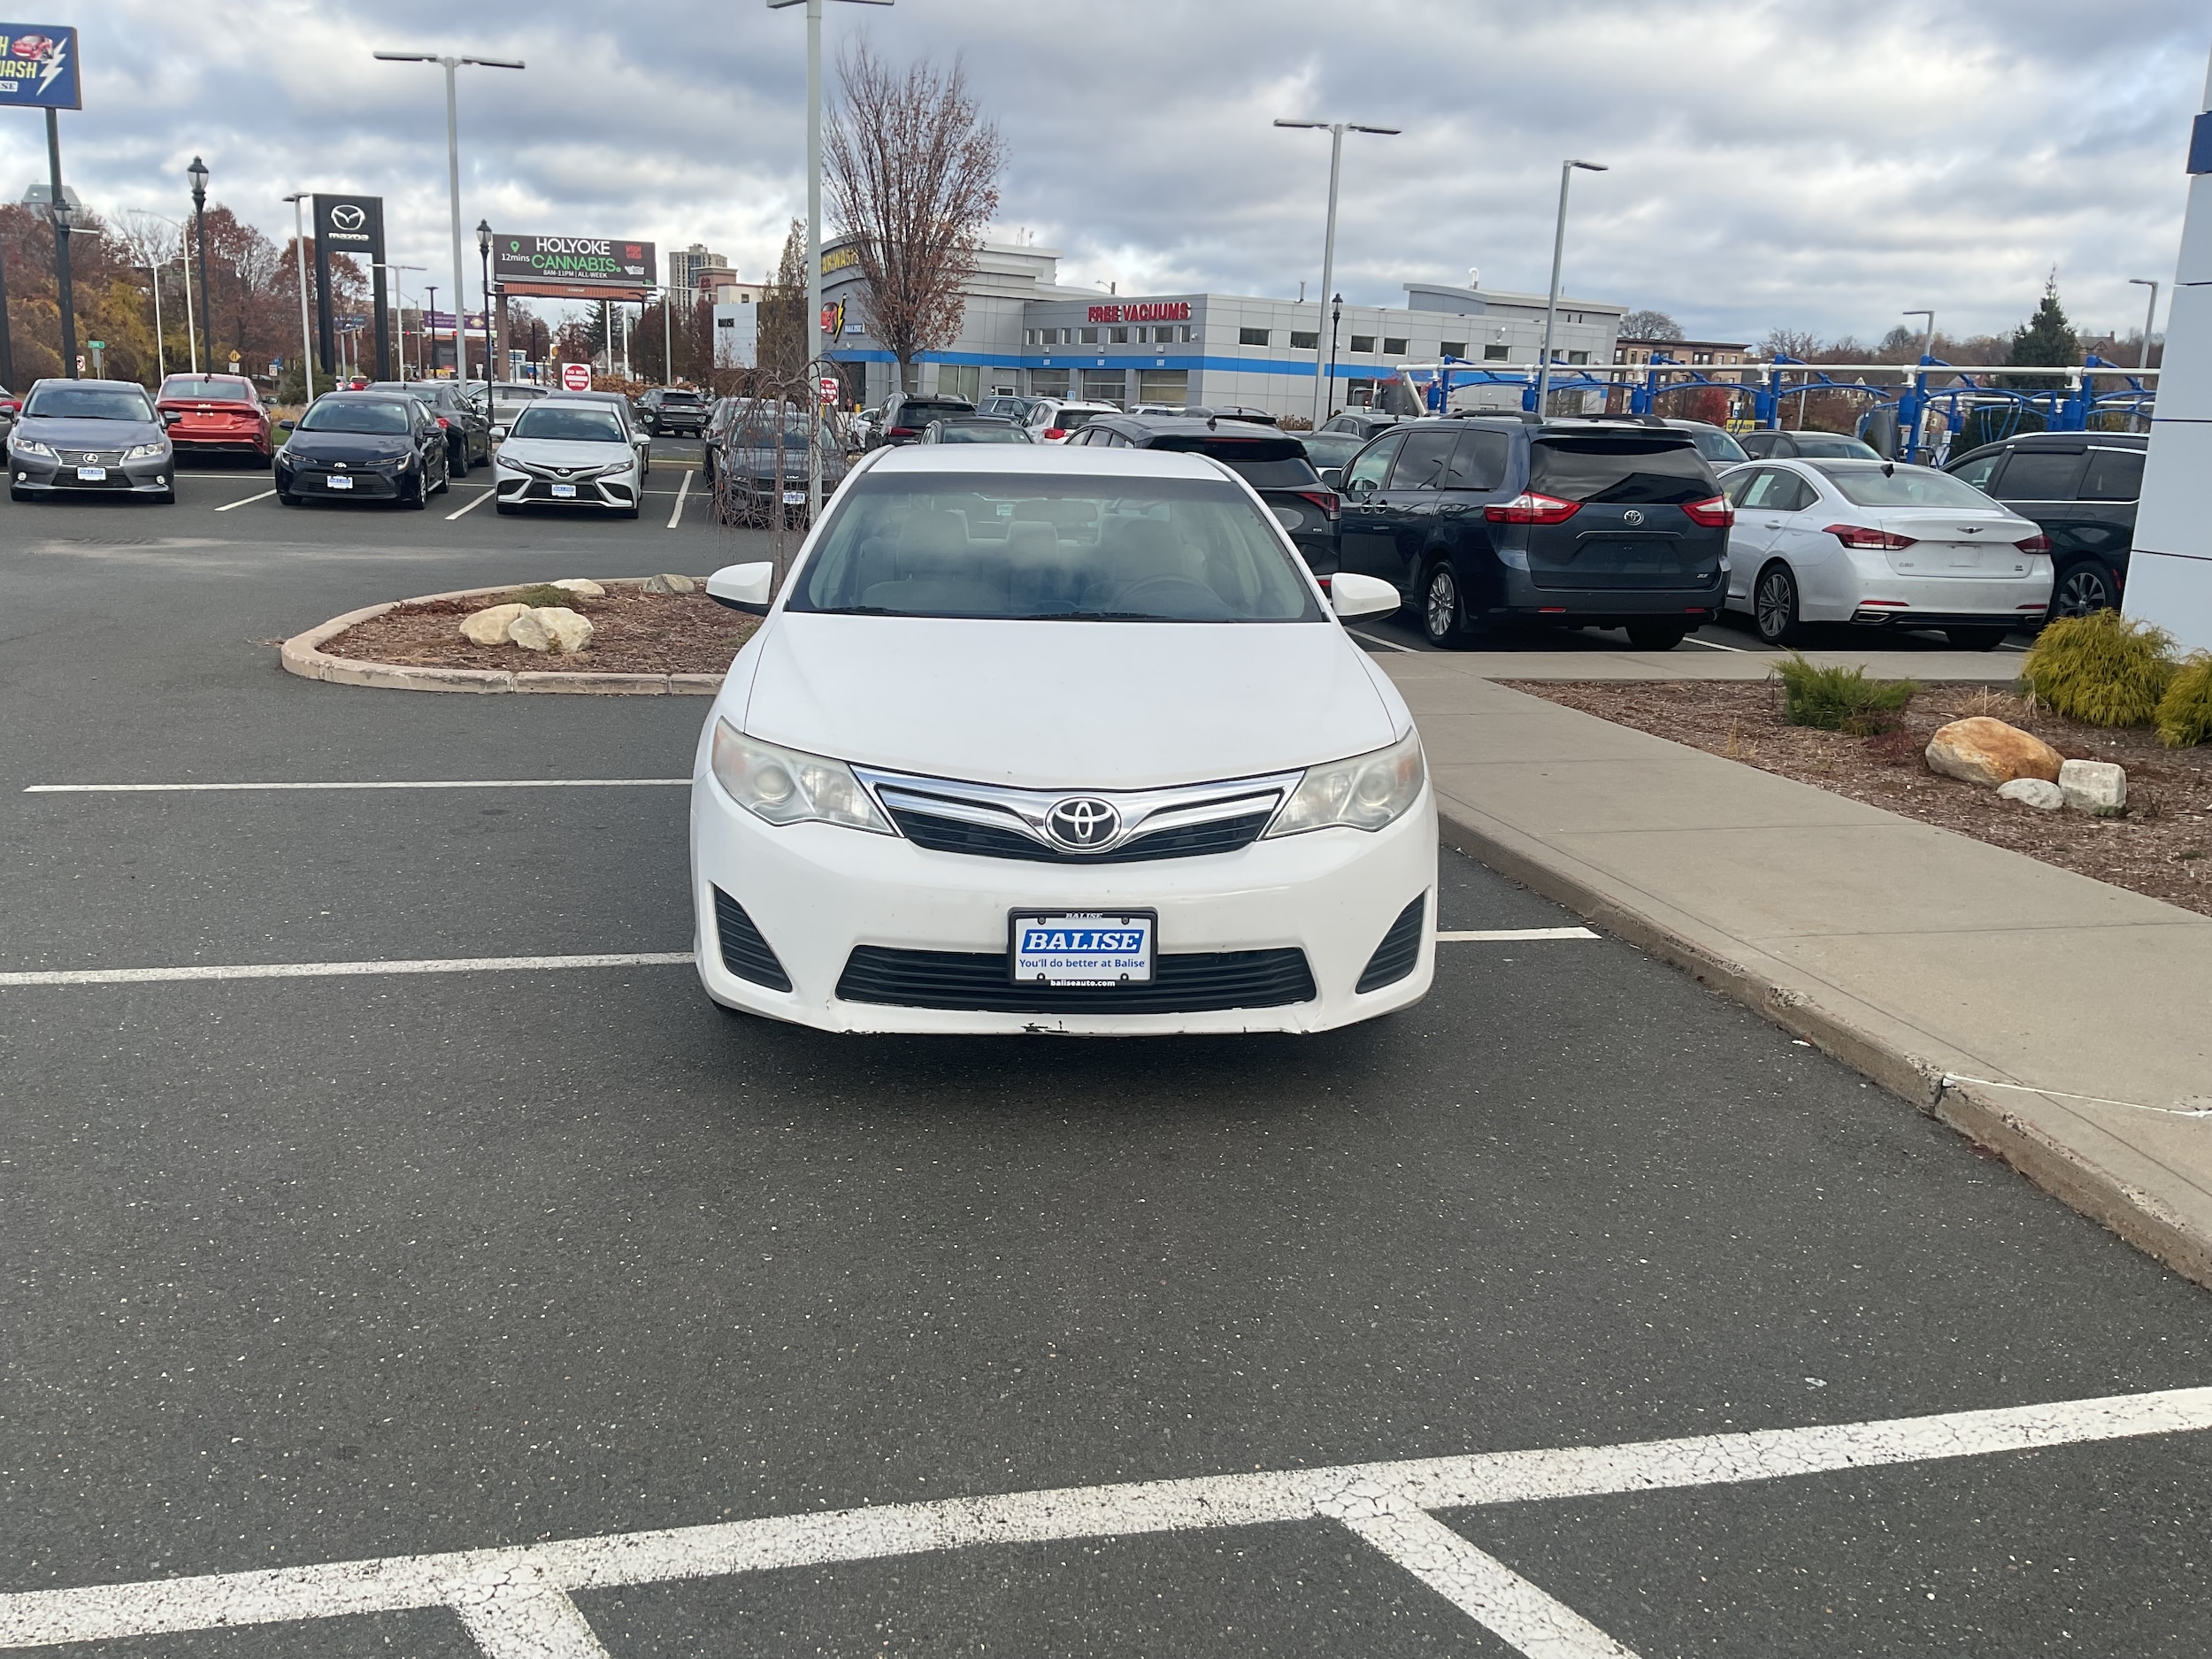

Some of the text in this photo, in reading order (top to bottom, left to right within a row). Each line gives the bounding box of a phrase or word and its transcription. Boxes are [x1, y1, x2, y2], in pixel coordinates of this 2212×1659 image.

[535, 237, 611, 256] HOLYOKE
[1088, 302, 1192, 323] FREE VACUUMS
[1025, 933, 1141, 951] BALISE
[1019, 958, 1146, 968] You'll do better at Balise
